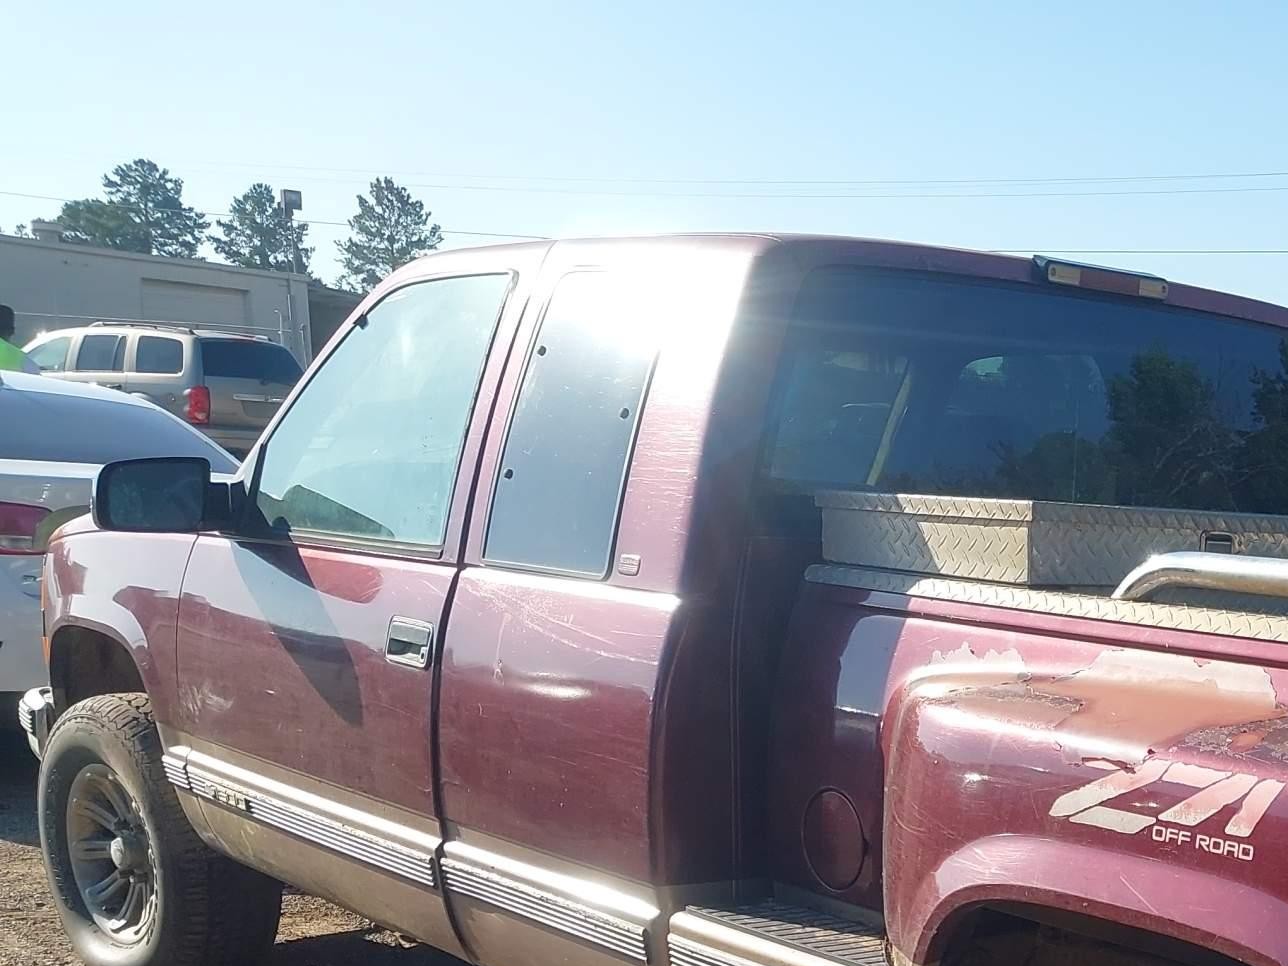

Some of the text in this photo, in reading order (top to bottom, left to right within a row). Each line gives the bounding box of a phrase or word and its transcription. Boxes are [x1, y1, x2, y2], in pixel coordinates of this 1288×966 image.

[1048, 757, 1288, 838] Z71
[1151, 825, 1255, 862] OFF ROAD
